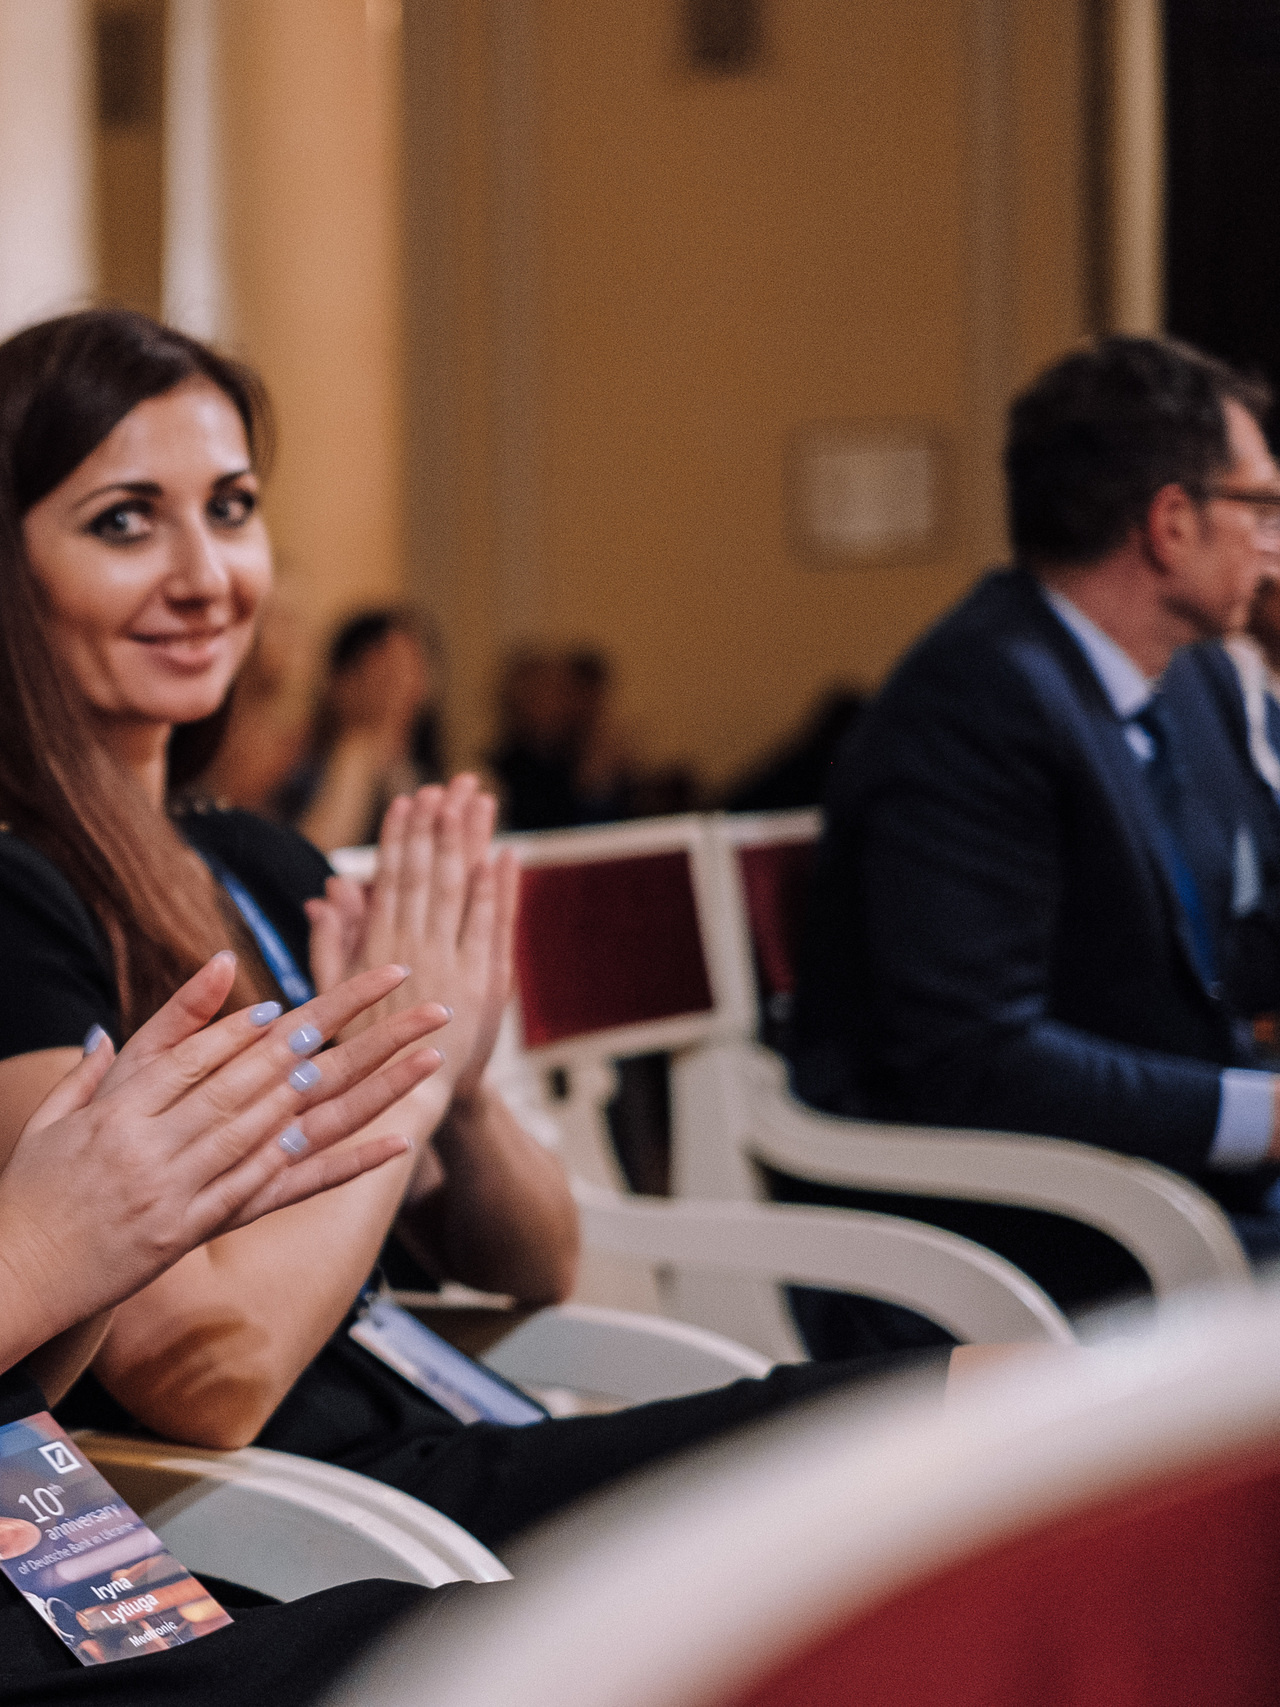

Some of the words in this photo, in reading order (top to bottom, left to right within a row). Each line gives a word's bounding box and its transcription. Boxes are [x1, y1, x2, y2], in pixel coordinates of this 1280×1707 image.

[45, 1504, 122, 1540] anniversary
[18, 1561, 31, 1575] of
[27, 1548, 72, 1571] Deutsche
[67, 1538, 95, 1554] Bank
[89, 1534, 104, 1546] in
[98, 1522, 137, 1541] Ukraine
[90, 1577, 134, 1600] Iryna
[101, 1594, 159, 1624] Lytiuga
